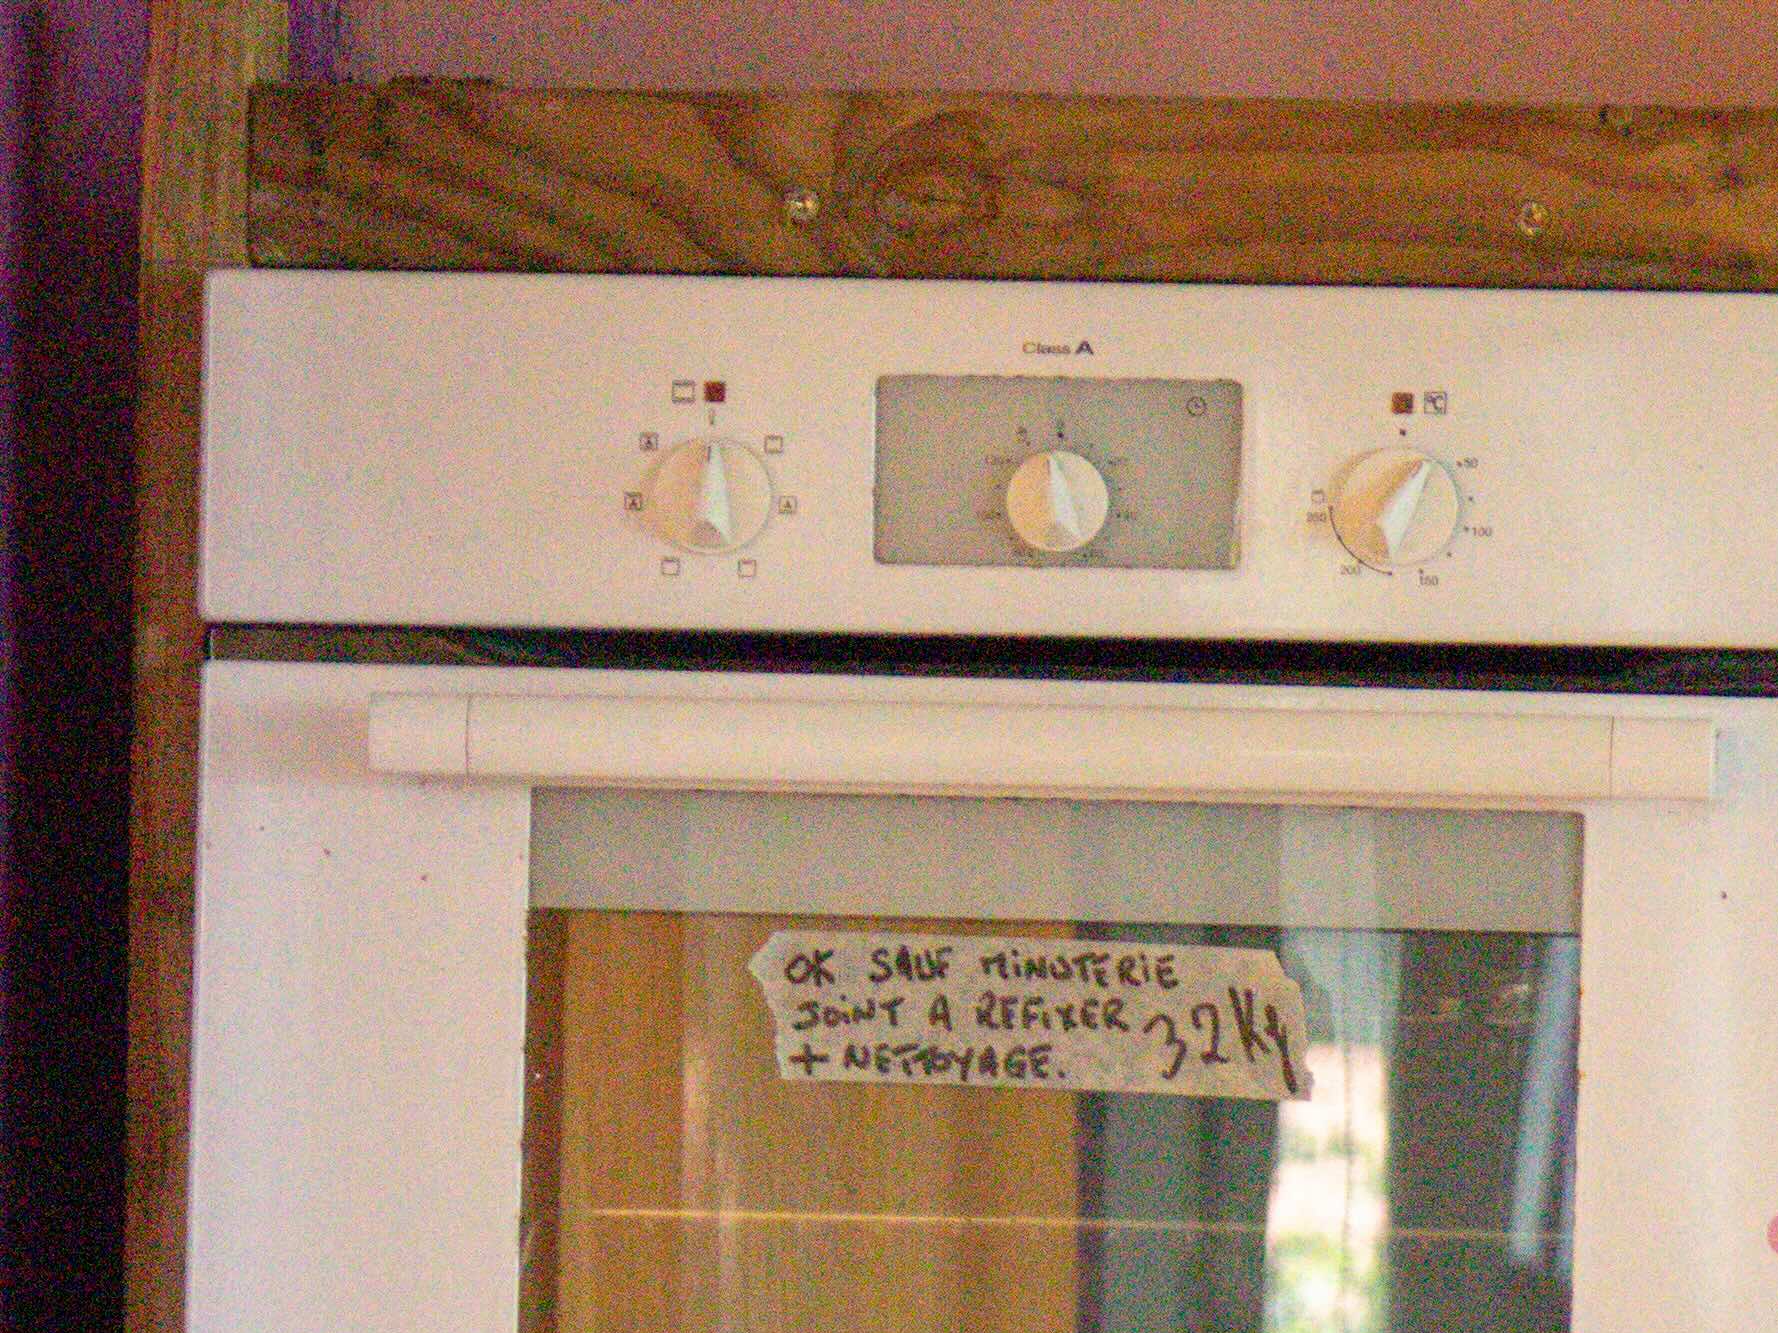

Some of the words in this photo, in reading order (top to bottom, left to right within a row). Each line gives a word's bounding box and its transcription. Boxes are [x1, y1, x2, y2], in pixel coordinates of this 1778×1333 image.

[1022, 341, 1071, 355] Class
[1075, 340, 1094, 355] A
[1472, 526, 1493, 537] 100
[784, 948, 835, 987] OK
[868, 945, 954, 983] SAUF
[927, 998, 953, 1032] A
